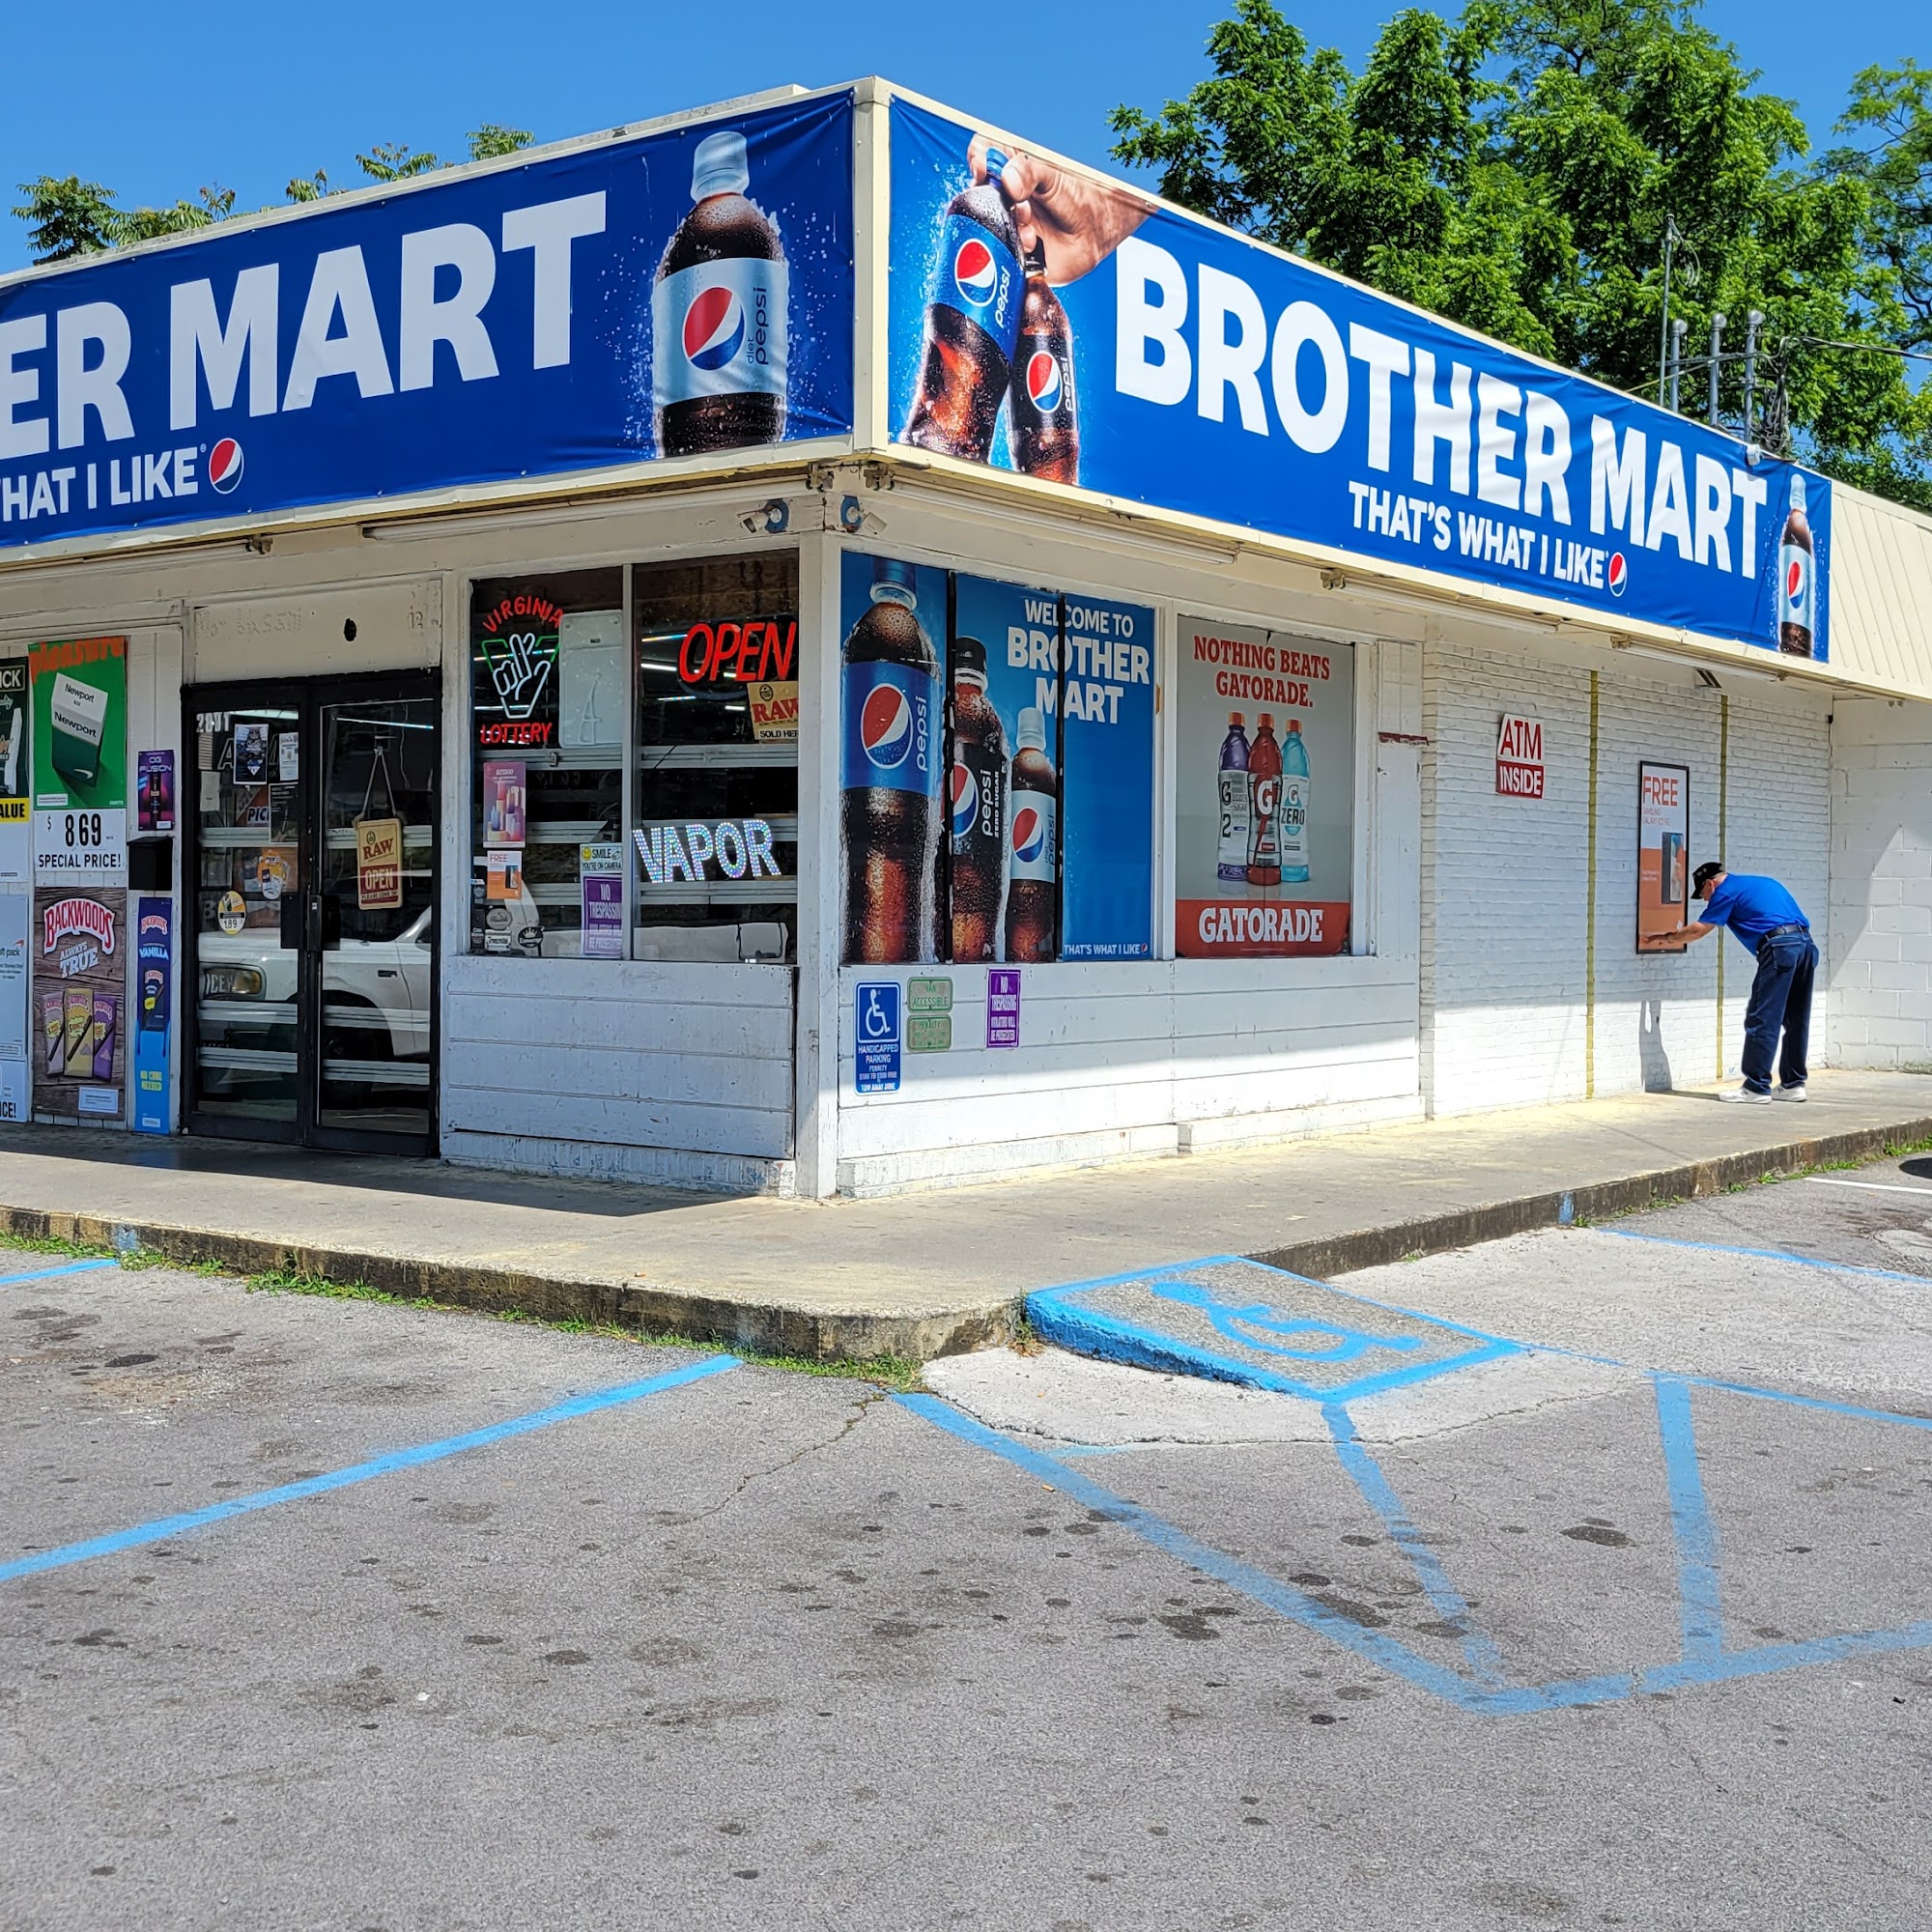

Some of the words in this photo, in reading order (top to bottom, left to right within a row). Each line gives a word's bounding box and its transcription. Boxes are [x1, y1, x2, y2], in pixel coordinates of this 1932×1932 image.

[170, 190, 607, 431] MART
[994, 268, 1011, 328] pepsi
[753, 287, 769, 365] pepsi
[1062, 356, 1076, 412] pepsi
[1115, 236, 1572, 526] BROTHER
[1590, 413, 1767, 580] MART
[87, 463, 98, 509] I
[110, 446, 199, 506] LIKE
[1349, 481, 1451, 551] THAT'S
[1458, 511, 1535, 569] WHAT
[1540, 533, 1548, 575] I
[1554, 542, 1605, 589] LIKE
[483, 596, 564, 633] VIRGINIA
[1025, 598, 1110, 634] WELCOME
[1112, 613, 1134, 638] TO
[679, 622, 797, 683] OPEN
[1008, 626, 1151, 685] BROTHER
[1193, 635, 1276, 672] NOTHING
[1280, 650, 1330, 681] BEATS
[64, 683, 95, 703] Newport
[1036, 676, 1124, 724] MART
[1215, 670, 1314, 708] GATORADE.
[54, 711, 97, 738] Newport
[752, 697, 799, 723] RAW
[480, 722, 553, 745] LOTTERY
[759, 729, 781, 738] SOLD
[915, 696, 928, 772] pepsi
[1499, 718, 1542, 760] ATM
[1222, 781, 1232, 806] G
[1288, 784, 1299, 806] G
[1499, 766, 1542, 796] INSIDE
[1642, 776, 1679, 808] FREE
[980, 769, 993, 837] pepsi
[1257, 780, 1273, 815] G
[1281, 808, 1305, 825] ZERO
[39, 854, 81, 868] SPECIAL
[84, 853, 121, 868] PRICE!
[362, 838, 394, 860] RAW
[490, 854, 508, 863] FREE
[591, 848, 611, 859] SMILE
[633, 819, 781, 884] VAPOR
[365, 867, 393, 891] OPEN
[582, 862, 596, 870] YOU'RE
[605, 861, 621, 869] CAMERA
[601, 883, 611, 901] NO
[46, 900, 112, 949] BACKWOODS
[1198, 907, 1323, 945] GATORADE
[60, 941, 88, 960] ALWAYS
[60, 947, 99, 979] TRUE
[139, 947, 169, 960] VANILLA
[1064, 944, 1092, 954] THAT'S
[1094, 944, 1117, 954] WHAT
[1123, 944, 1140, 954] LIKE
[913, 996, 949, 1008] ACCESSIBLE
[858, 1044, 898, 1054] HANDICAPPED
[866, 1054, 892, 1064] PARKING
